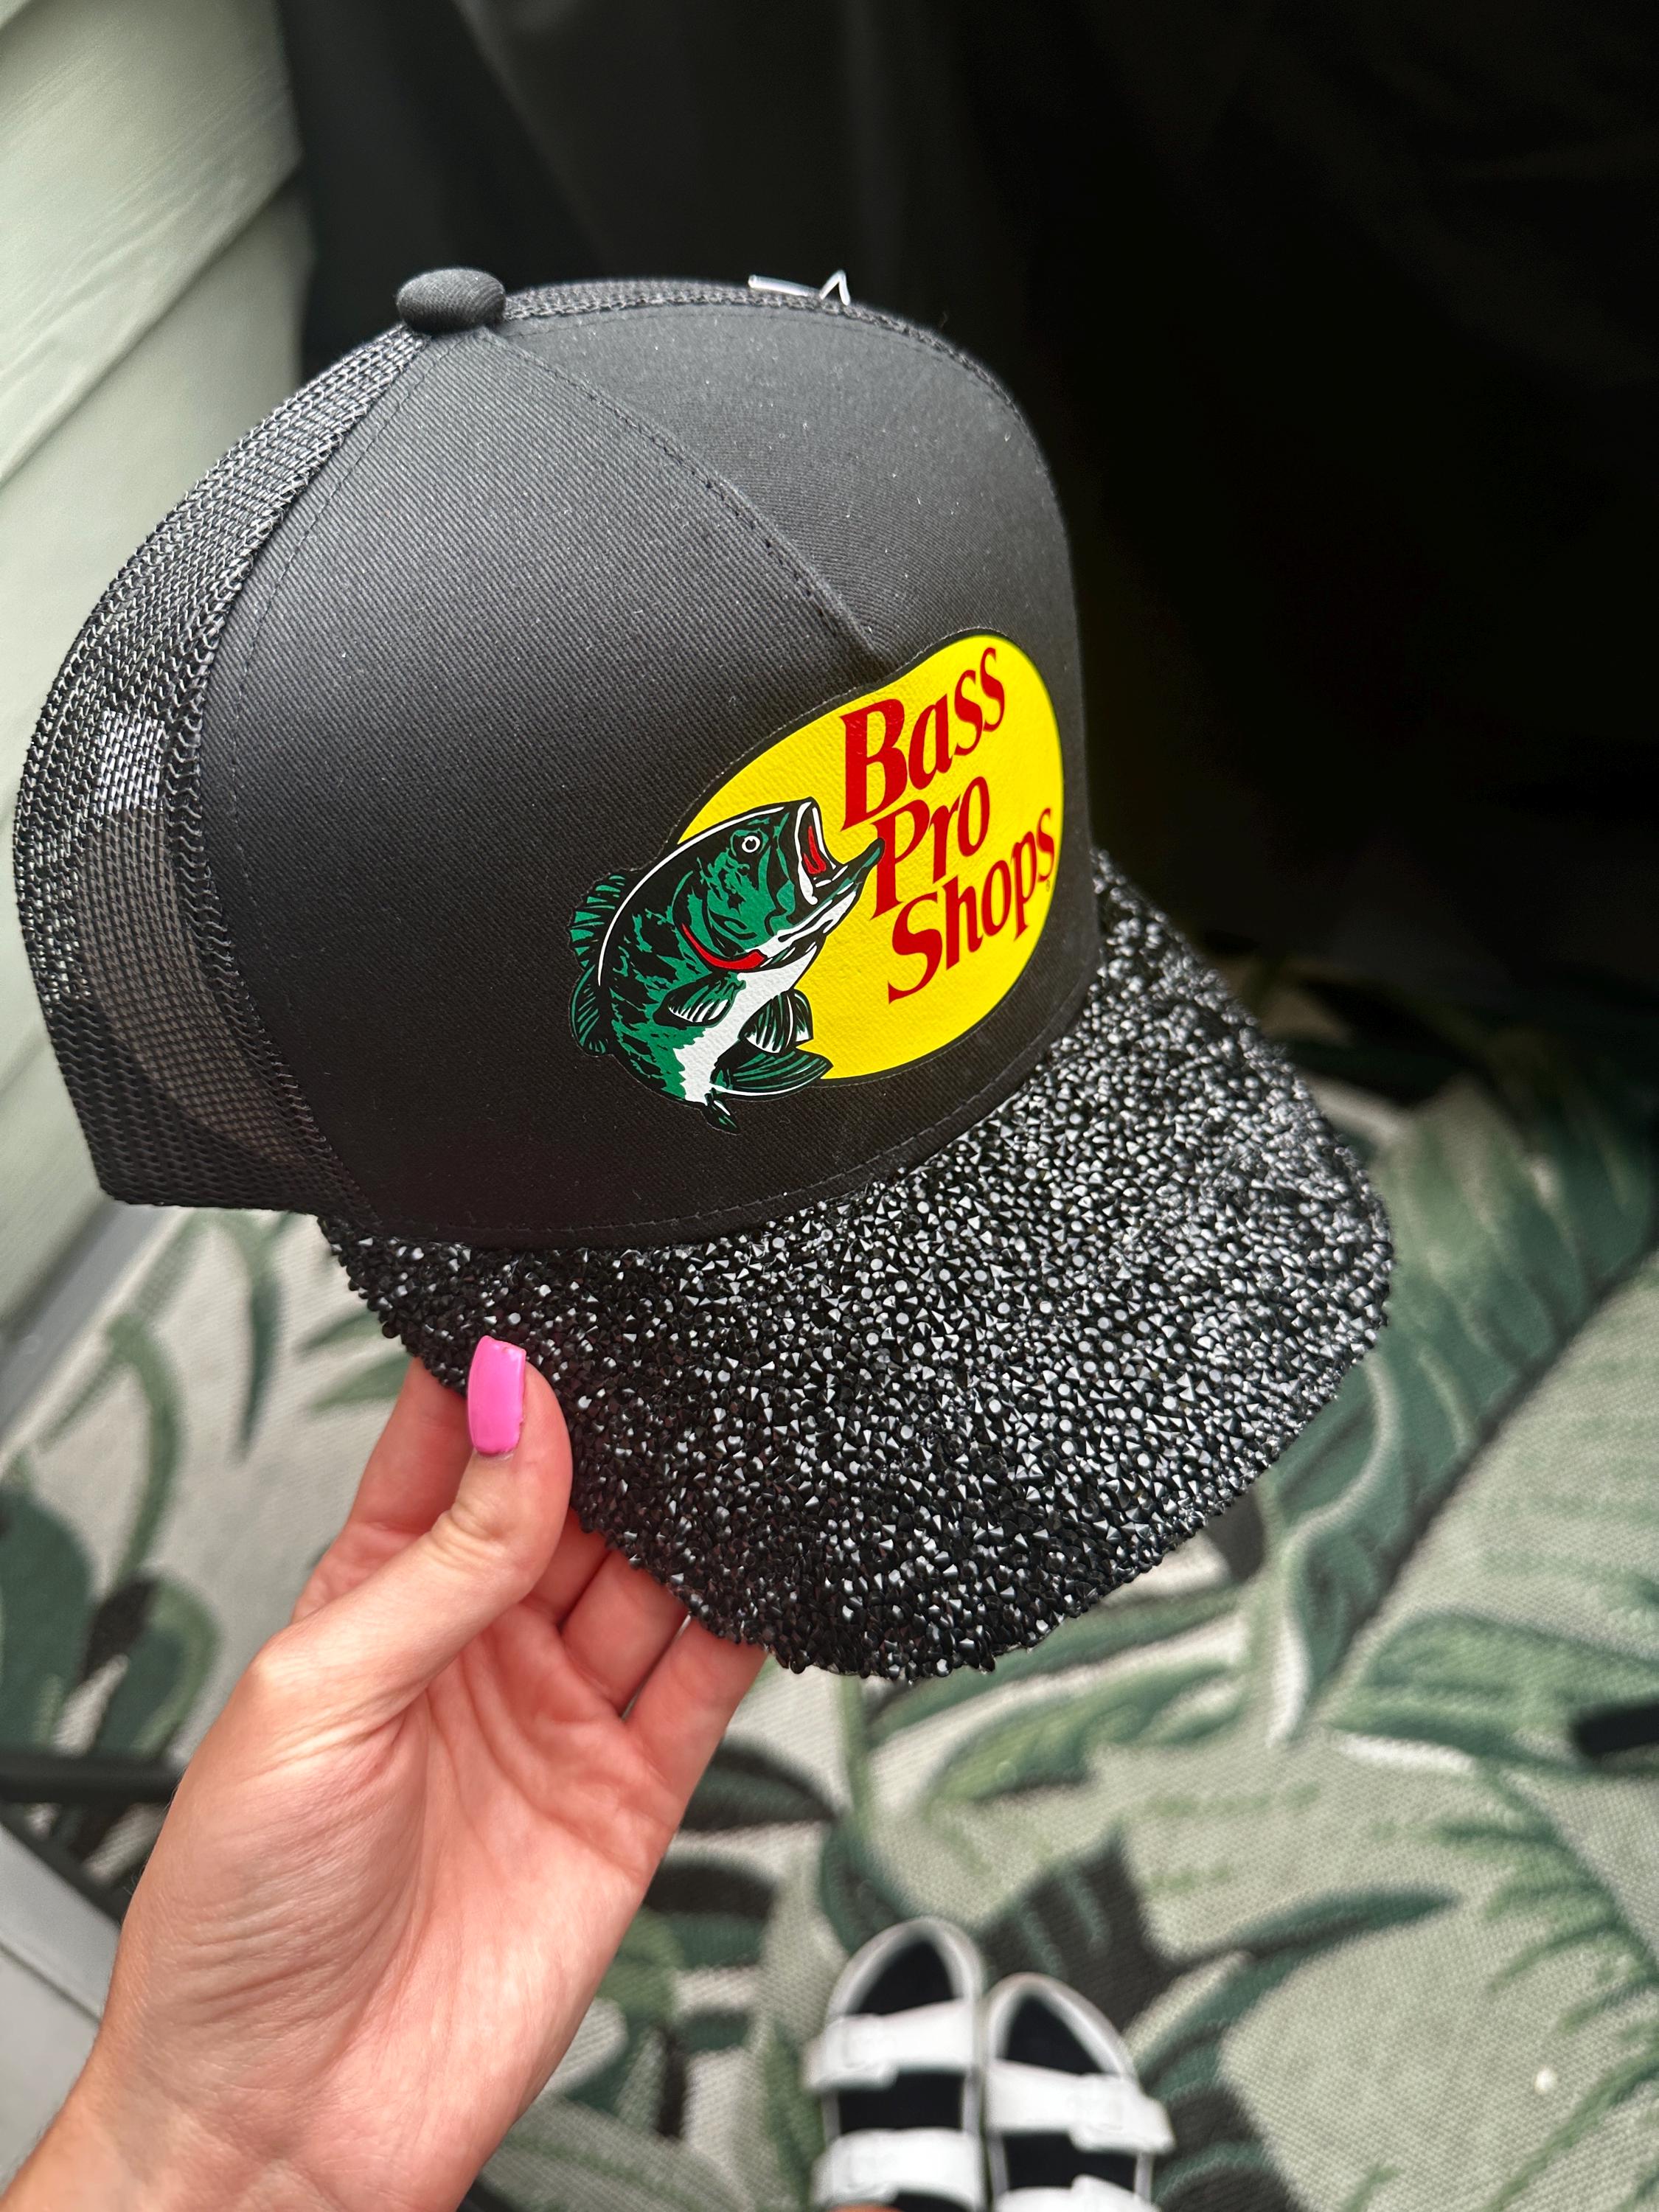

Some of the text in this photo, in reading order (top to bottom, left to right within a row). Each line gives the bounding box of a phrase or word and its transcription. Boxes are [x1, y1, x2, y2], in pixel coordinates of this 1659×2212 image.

[840, 647, 1005, 831] Bass
[870, 776, 990, 920] Pro
[888, 808, 1055, 1004] Shops
